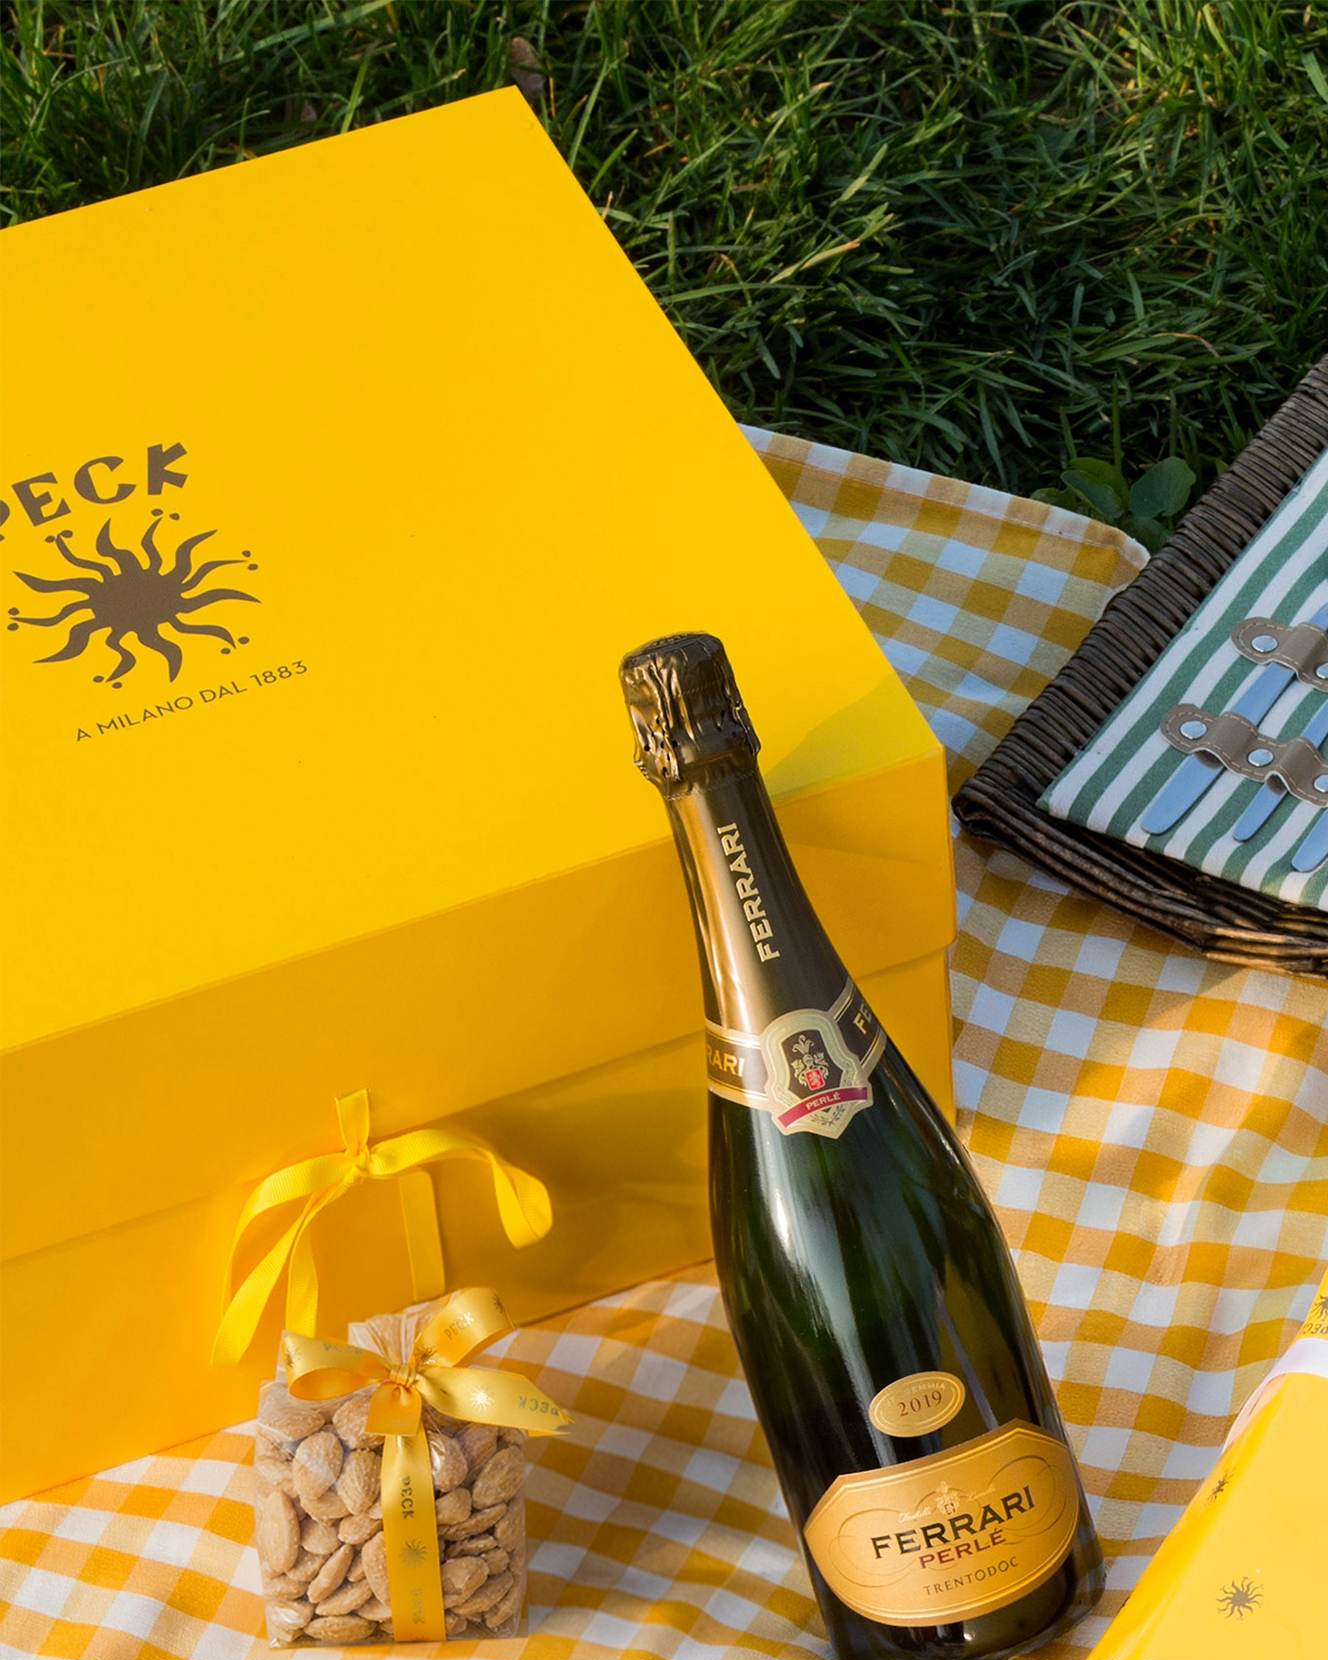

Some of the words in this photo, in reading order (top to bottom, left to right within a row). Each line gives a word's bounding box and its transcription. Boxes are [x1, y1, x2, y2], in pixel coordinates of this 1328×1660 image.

[0, 442, 188, 527] ECK
[76, 728, 92, 742] A
[96, 695, 194, 735] MILANO
[199, 680, 248, 704] DAL
[249, 660, 309, 687] 1883
[717, 822, 780, 964] FERRARI
[806, 1091, 841, 1110] PERLÉ
[897, 1390, 942, 1416] 2019
[400, 1475, 415, 1520] PECK
[871, 1485, 1036, 1560] FERRARI
[919, 1528, 1007, 1569] PERLÉ
[923, 1556, 1019, 1596] TRENTODOC
